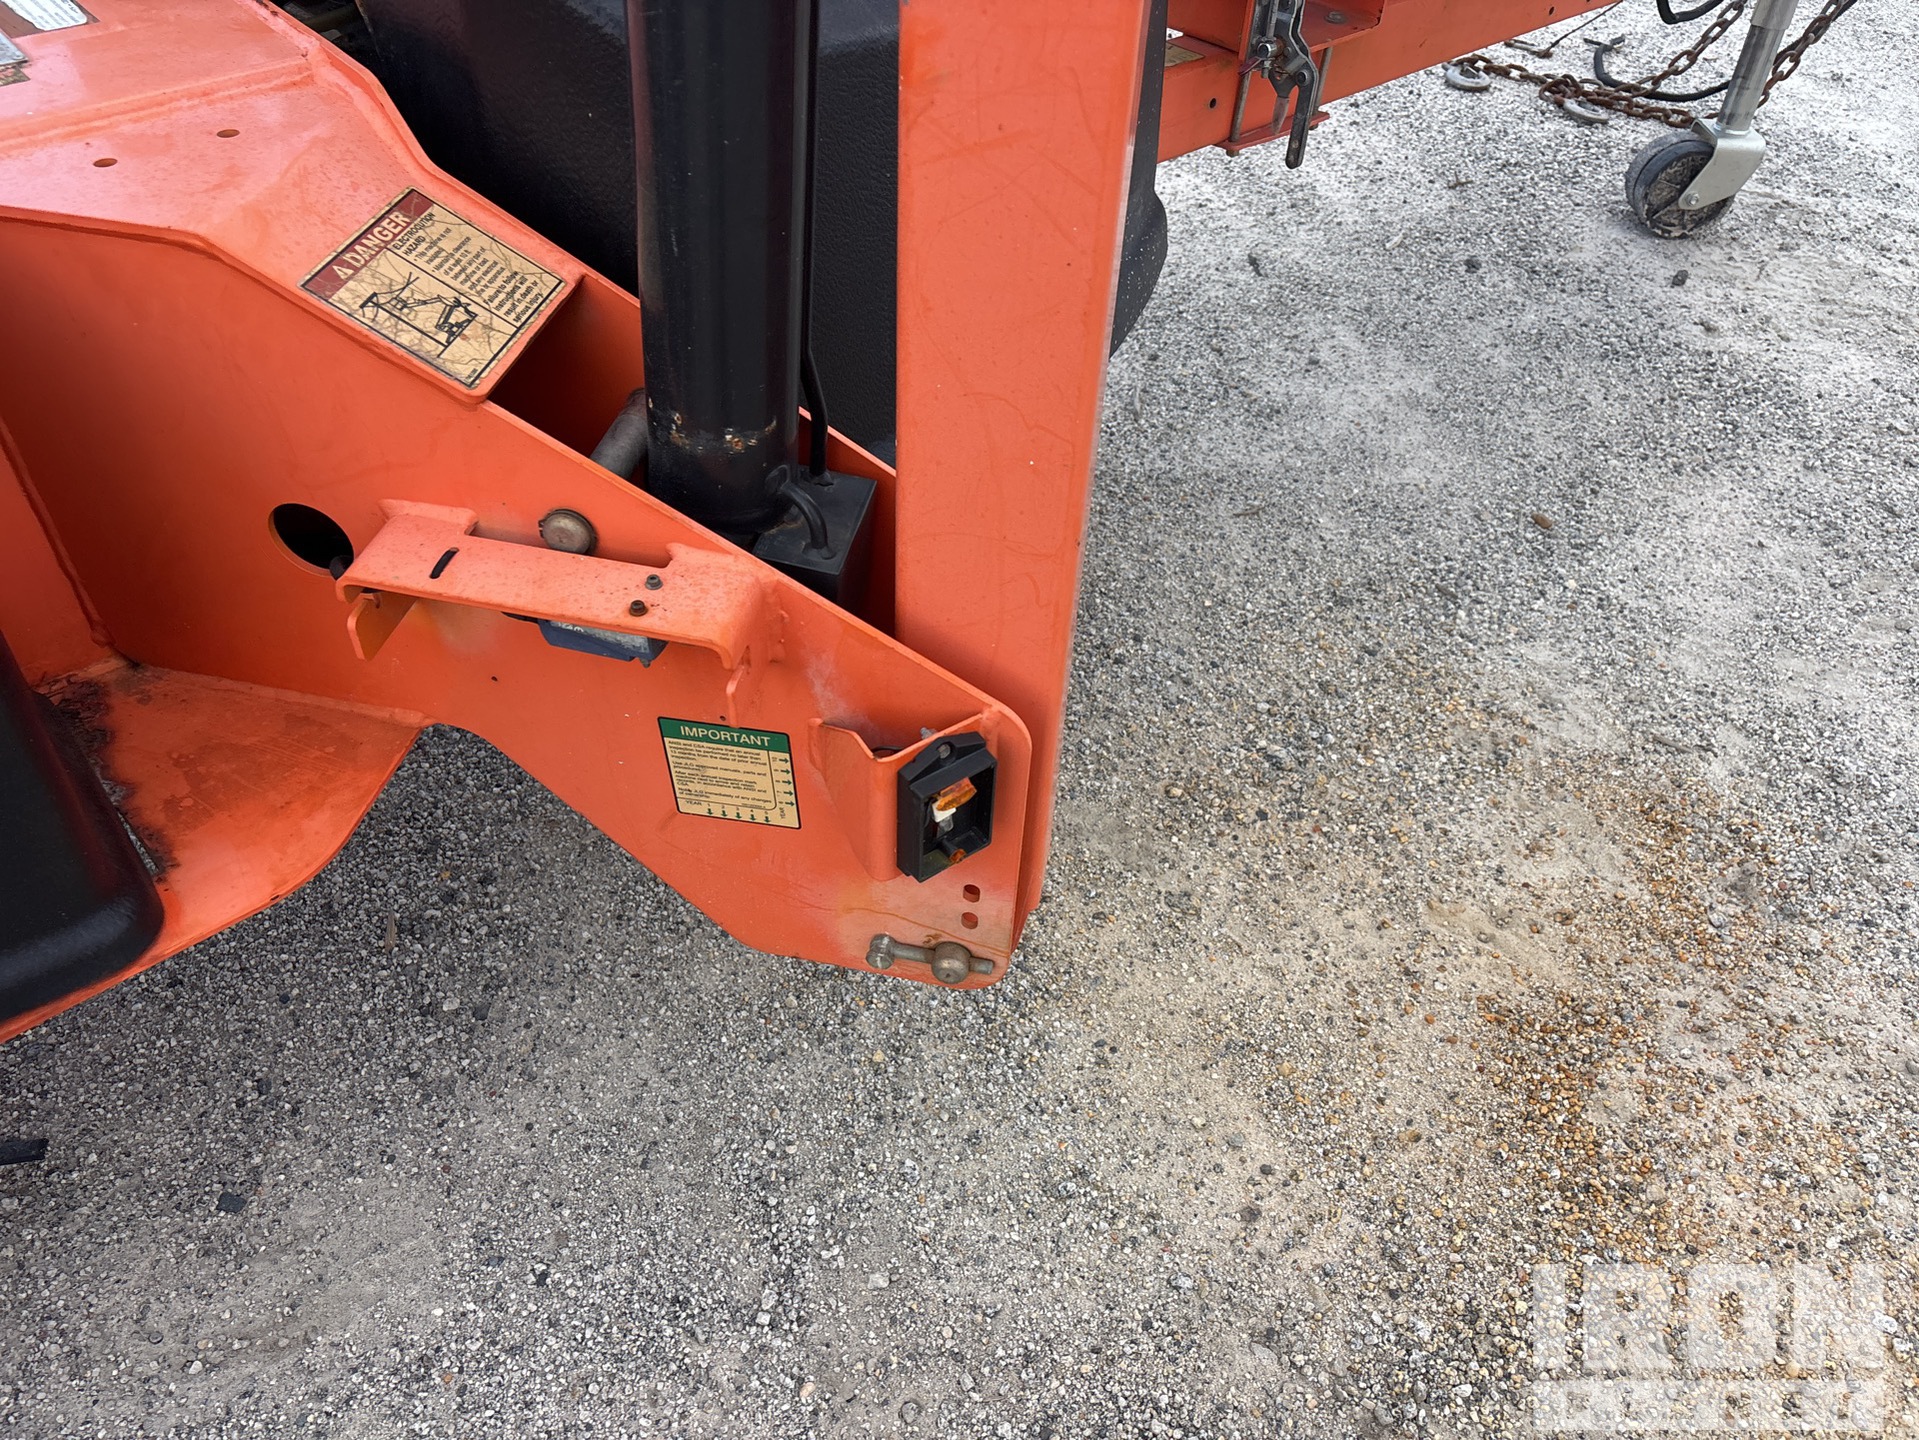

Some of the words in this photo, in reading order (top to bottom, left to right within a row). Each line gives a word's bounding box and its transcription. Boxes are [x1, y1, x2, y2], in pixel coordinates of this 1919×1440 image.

[341, 210, 412, 267] DANGER
[391, 211, 436, 250] ELECTROCUTION
[401, 234, 426, 256] HAZARD
[423, 236, 442, 252] machine
[451, 236, 471, 253] clearance
[471, 250, 483, 260] part
[482, 287, 502, 305] Failure
[501, 269, 519, 285] follow
[516, 276, 527, 285] will
[502, 302, 518, 317] result
[518, 284, 534, 299] death
[511, 304, 531, 323] serious
[680, 726, 771, 746] IMPORTANT
